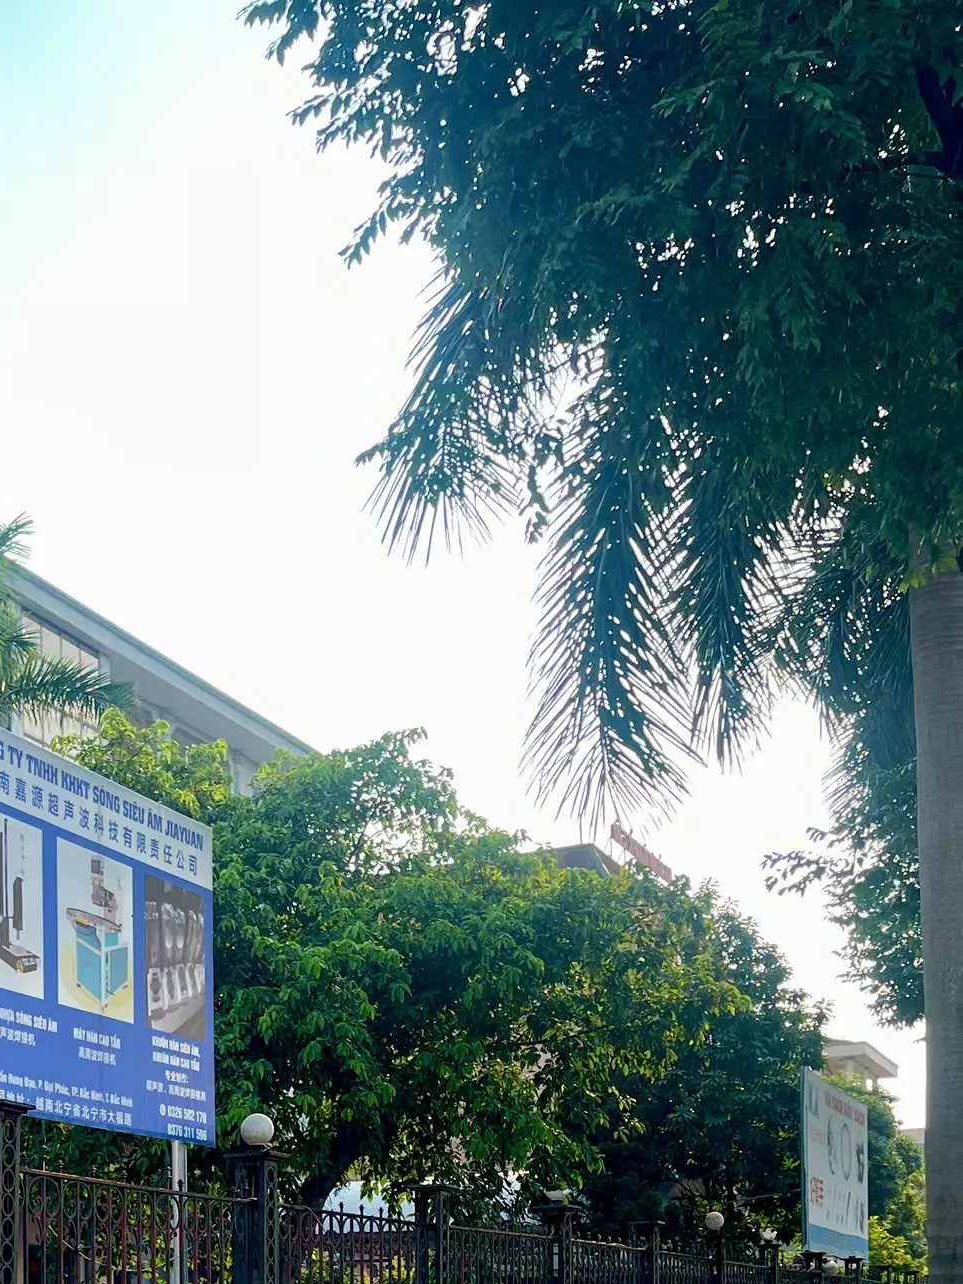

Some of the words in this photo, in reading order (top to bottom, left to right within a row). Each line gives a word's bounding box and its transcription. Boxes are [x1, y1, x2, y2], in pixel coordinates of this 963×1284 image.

[8, 745, 23, 769] TY
[26, 754, 58, 786] TNHH
[61, 769, 90, 799] KHKT
[93, 785, 120, 814] SÓNG
[123, 801, 145, 825] SIÊU
[147, 808, 163, 833] ÂM
[165, 820, 204, 851] JIAYUAN
